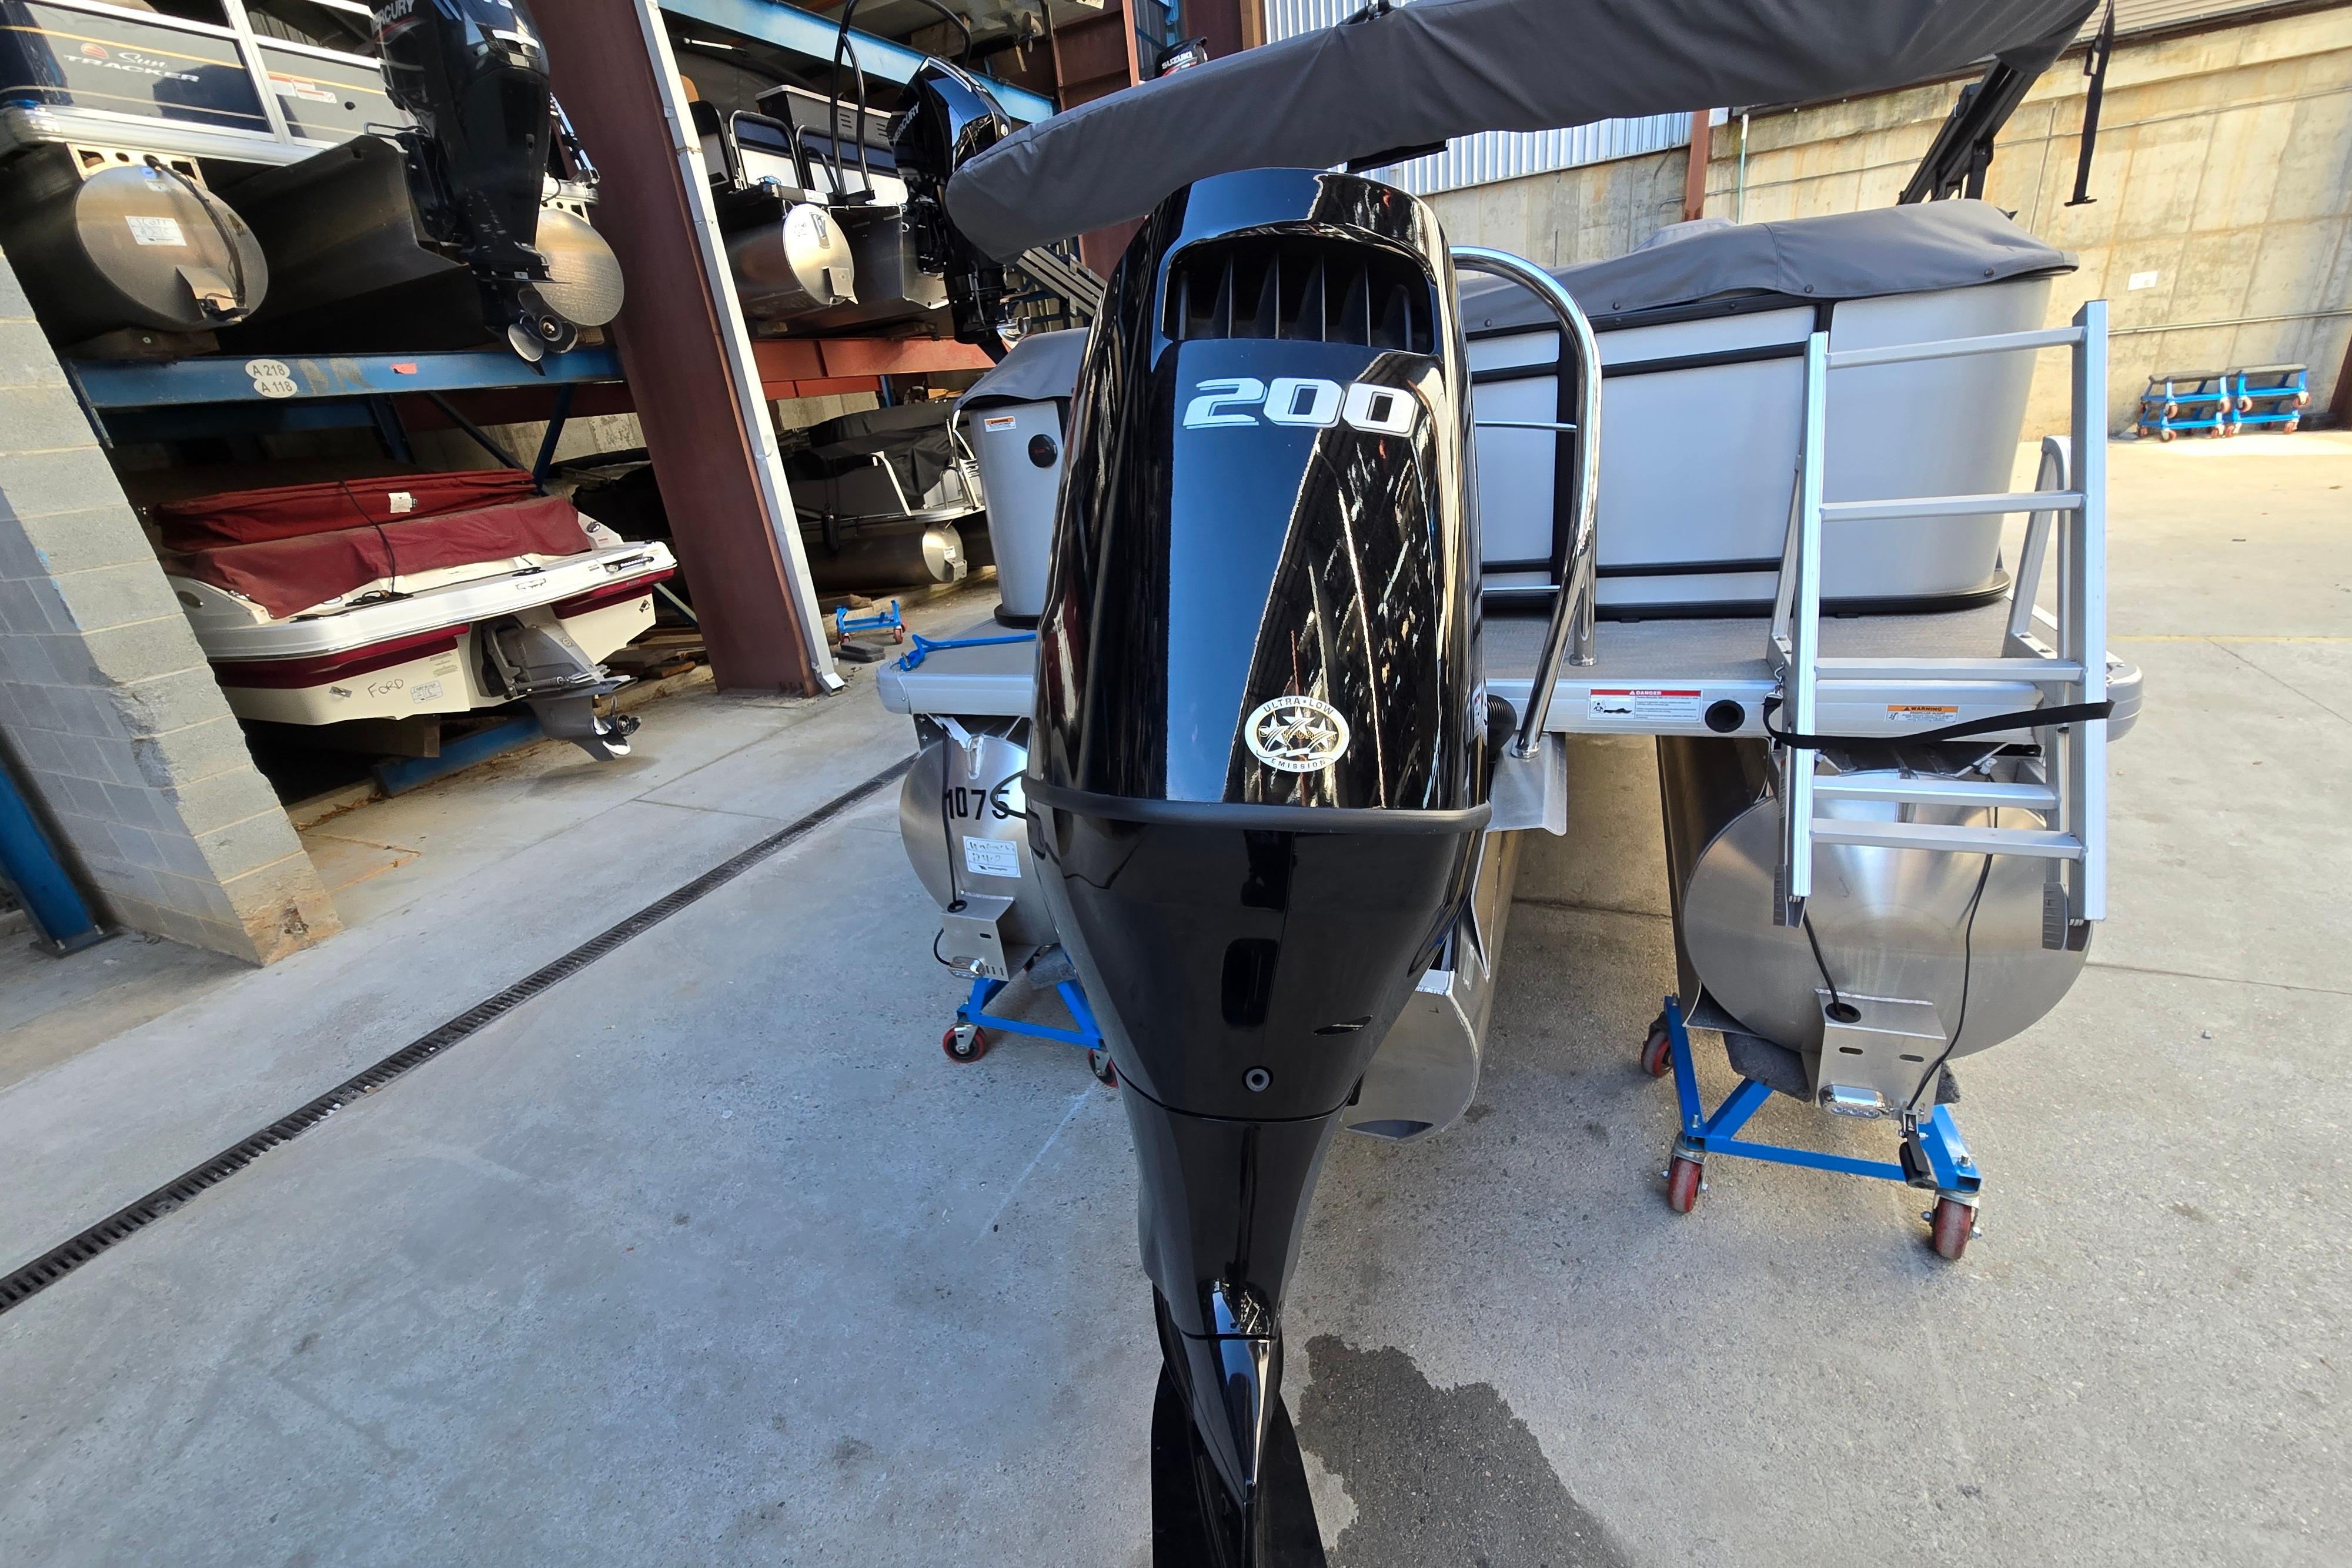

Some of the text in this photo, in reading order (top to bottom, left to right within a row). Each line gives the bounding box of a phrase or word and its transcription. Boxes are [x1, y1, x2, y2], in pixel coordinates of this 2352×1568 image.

[63, 54, 200, 82] TRACKER
[118, 52, 168, 68] Sun
[1161, 51, 1193, 69] SUZUKI
[253, 365, 286, 376] A 218
[261, 380, 293, 393] A 118
[1183, 377, 1419, 438] 200
[367, 678, 404, 698] FORD
[1263, 697, 1334, 714] ULTRA LOW
[1271, 758, 1326, 769] EMISSION
